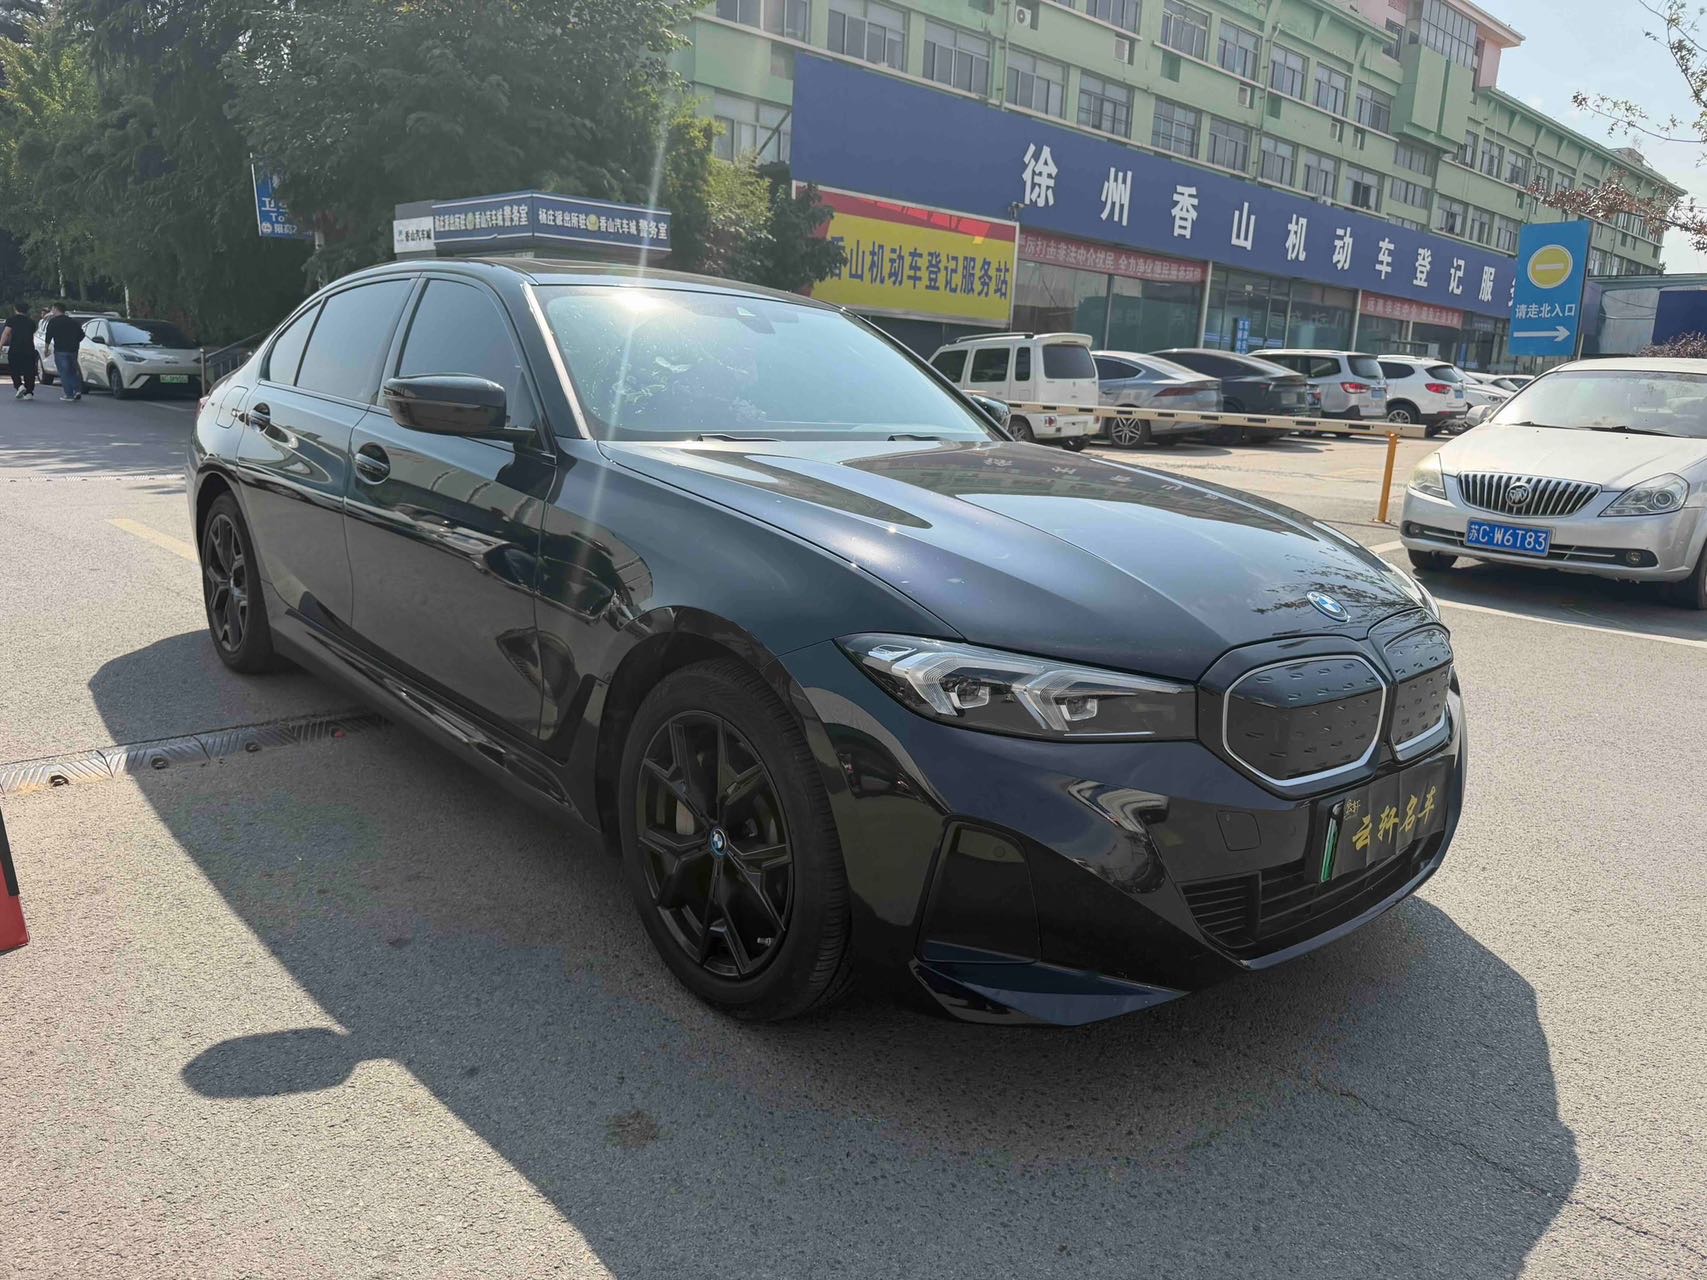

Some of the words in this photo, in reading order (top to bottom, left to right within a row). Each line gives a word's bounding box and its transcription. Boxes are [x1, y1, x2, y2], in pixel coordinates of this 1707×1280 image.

[1515, 303, 1576, 319] 请走北入口
[1468, 524, 1547, 550] 苏C·W6T83
